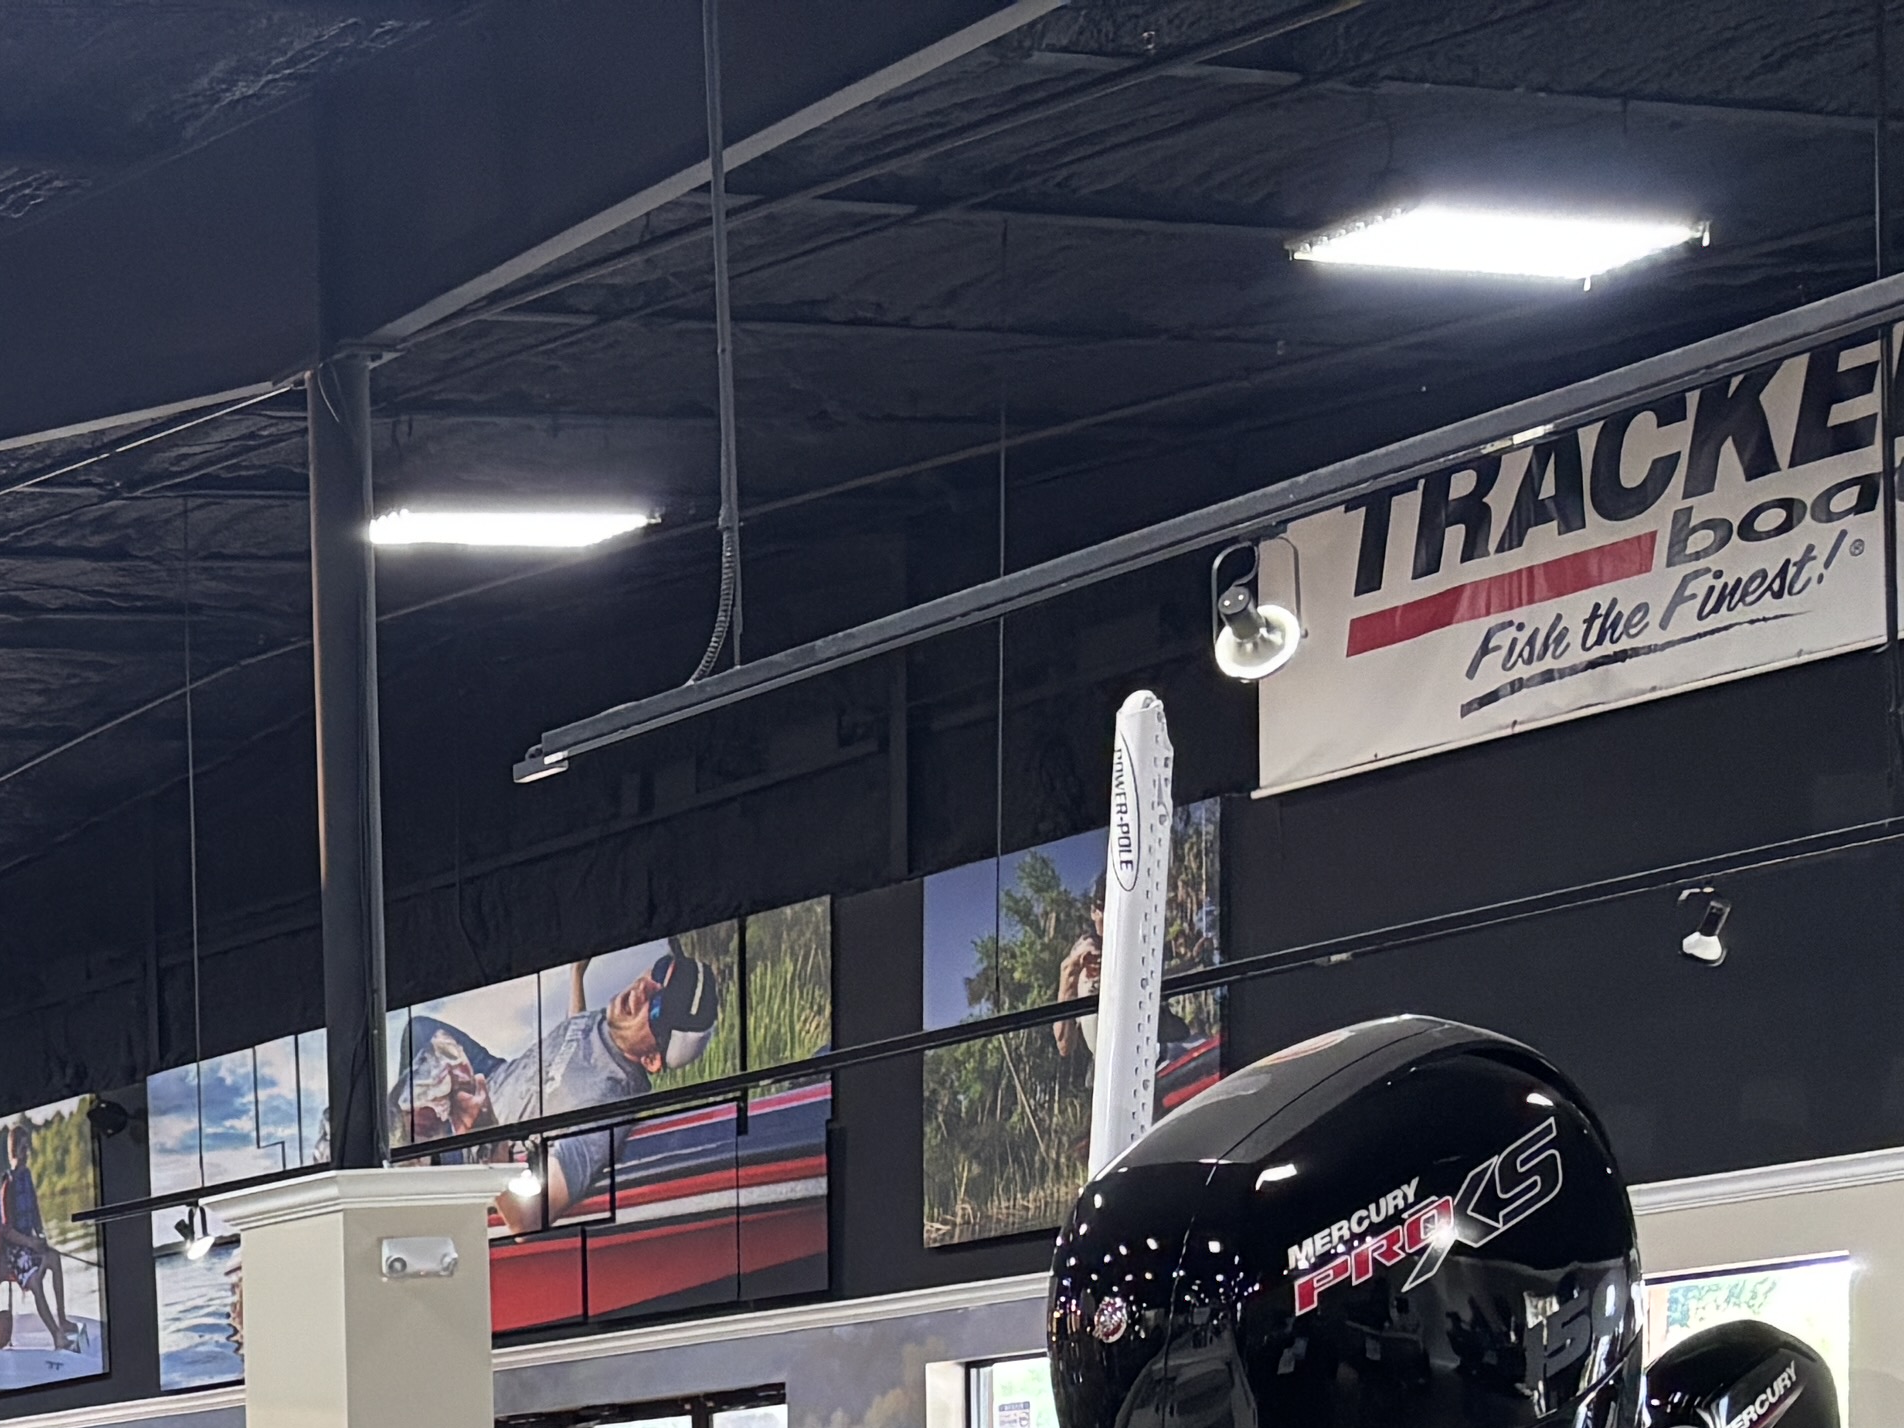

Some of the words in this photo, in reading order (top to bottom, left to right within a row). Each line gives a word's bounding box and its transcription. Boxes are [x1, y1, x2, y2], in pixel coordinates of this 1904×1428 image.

[1344, 330, 1904, 597] TRACKE
[1666, 470, 1904, 568] boa
[1465, 612, 1571, 680] Fish
[1581, 596, 1651, 652] the
[1658, 528, 1850, 632] Finest!
[1287, 1176, 1420, 1270] MERCURY
